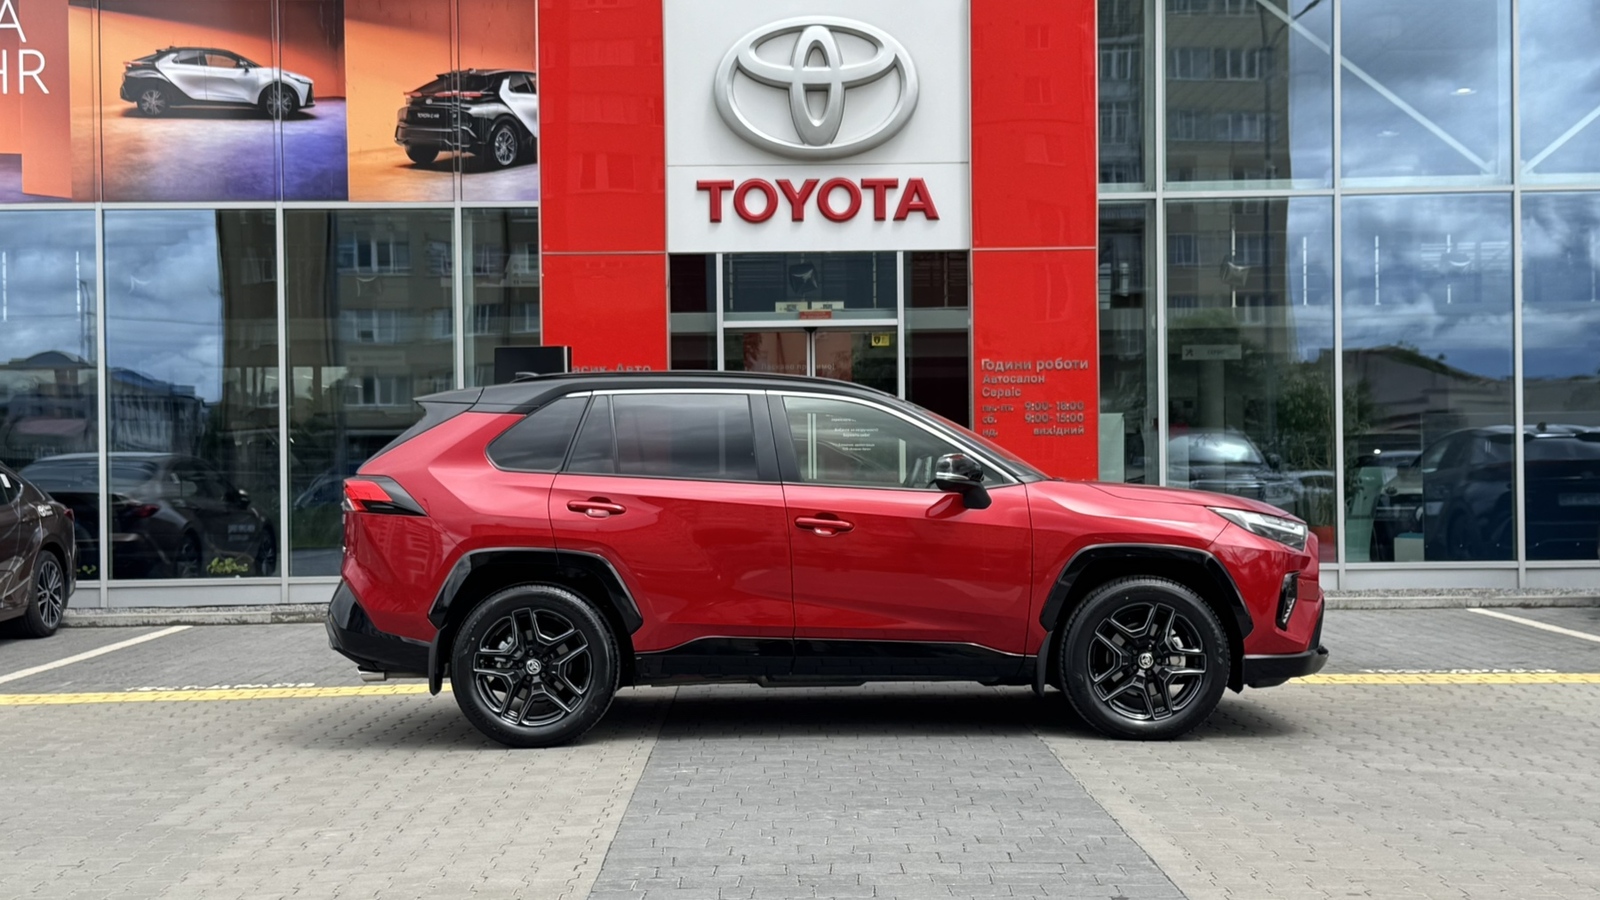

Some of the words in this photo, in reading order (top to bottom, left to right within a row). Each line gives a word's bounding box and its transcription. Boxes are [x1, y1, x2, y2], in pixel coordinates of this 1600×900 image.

[696, 177, 940, 224] TOYOTA
[981, 358, 1032, 372] Години
[1036, 357, 1089, 373] роботи
[982, 375, 1045, 384] Автосалон
[982, 386, 1021, 399] Сервіс
[1056, 413, 1084, 422] 15:00
[1033, 425, 1084, 436] вихідний
